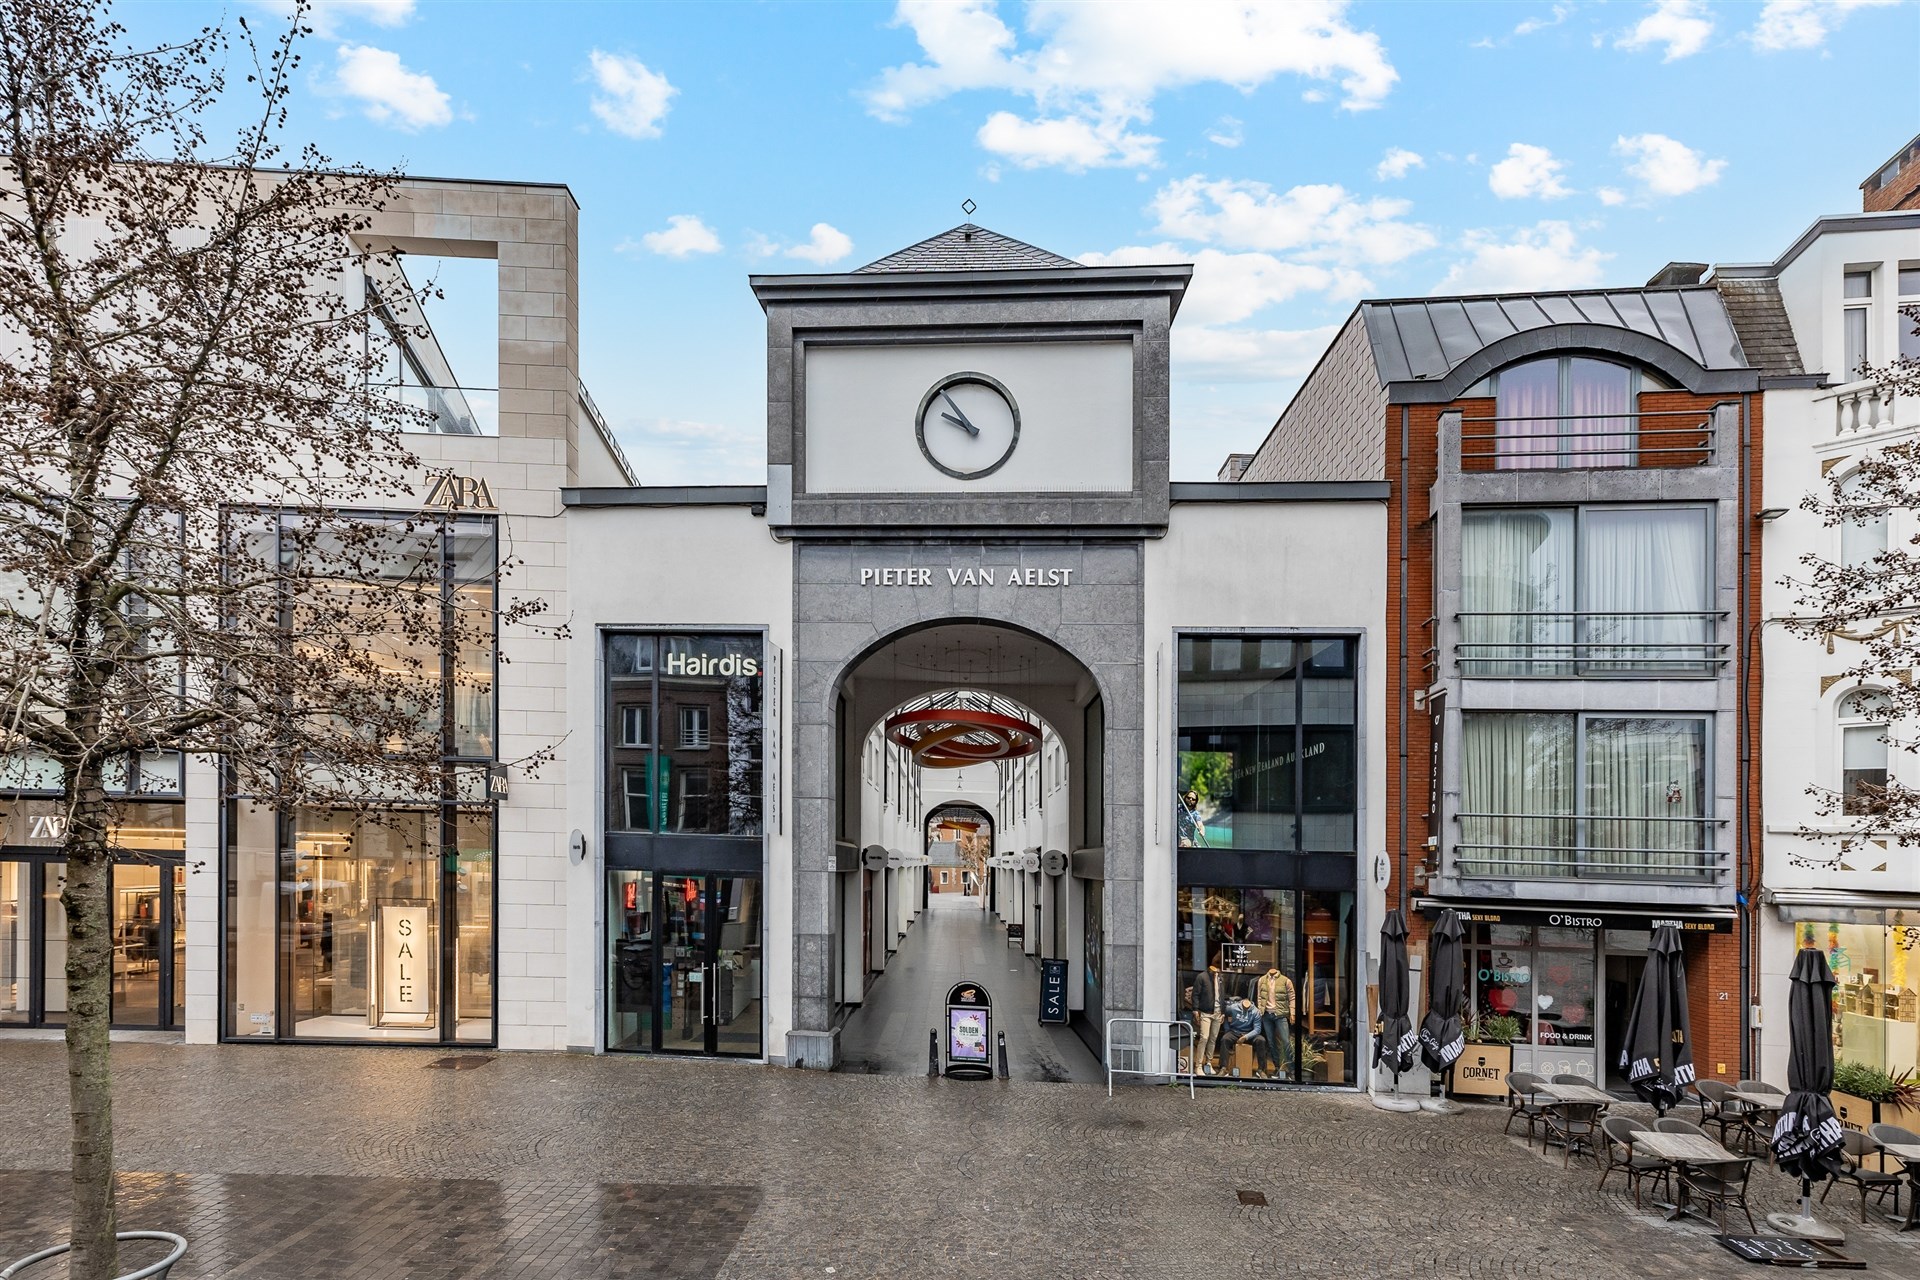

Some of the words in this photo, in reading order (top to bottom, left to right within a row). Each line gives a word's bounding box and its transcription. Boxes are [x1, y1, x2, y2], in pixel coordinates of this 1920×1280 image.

[424, 475, 499, 510] ZARA
[861, 568, 932, 586] PIETER
[947, 568, 994, 586] VAN
[1008, 568, 1073, 586] AELST
[490, 774, 509, 794] ZARA
[398, 919, 413, 1003] SALE
[1048, 976, 1060, 1015] SALE
[1719, 992, 1729, 1000] 21
[959, 1026, 979, 1034] SOLDEN
[1569, 1033, 1593, 1041] DRINK
[1463, 1066, 1501, 1081] CORNET
